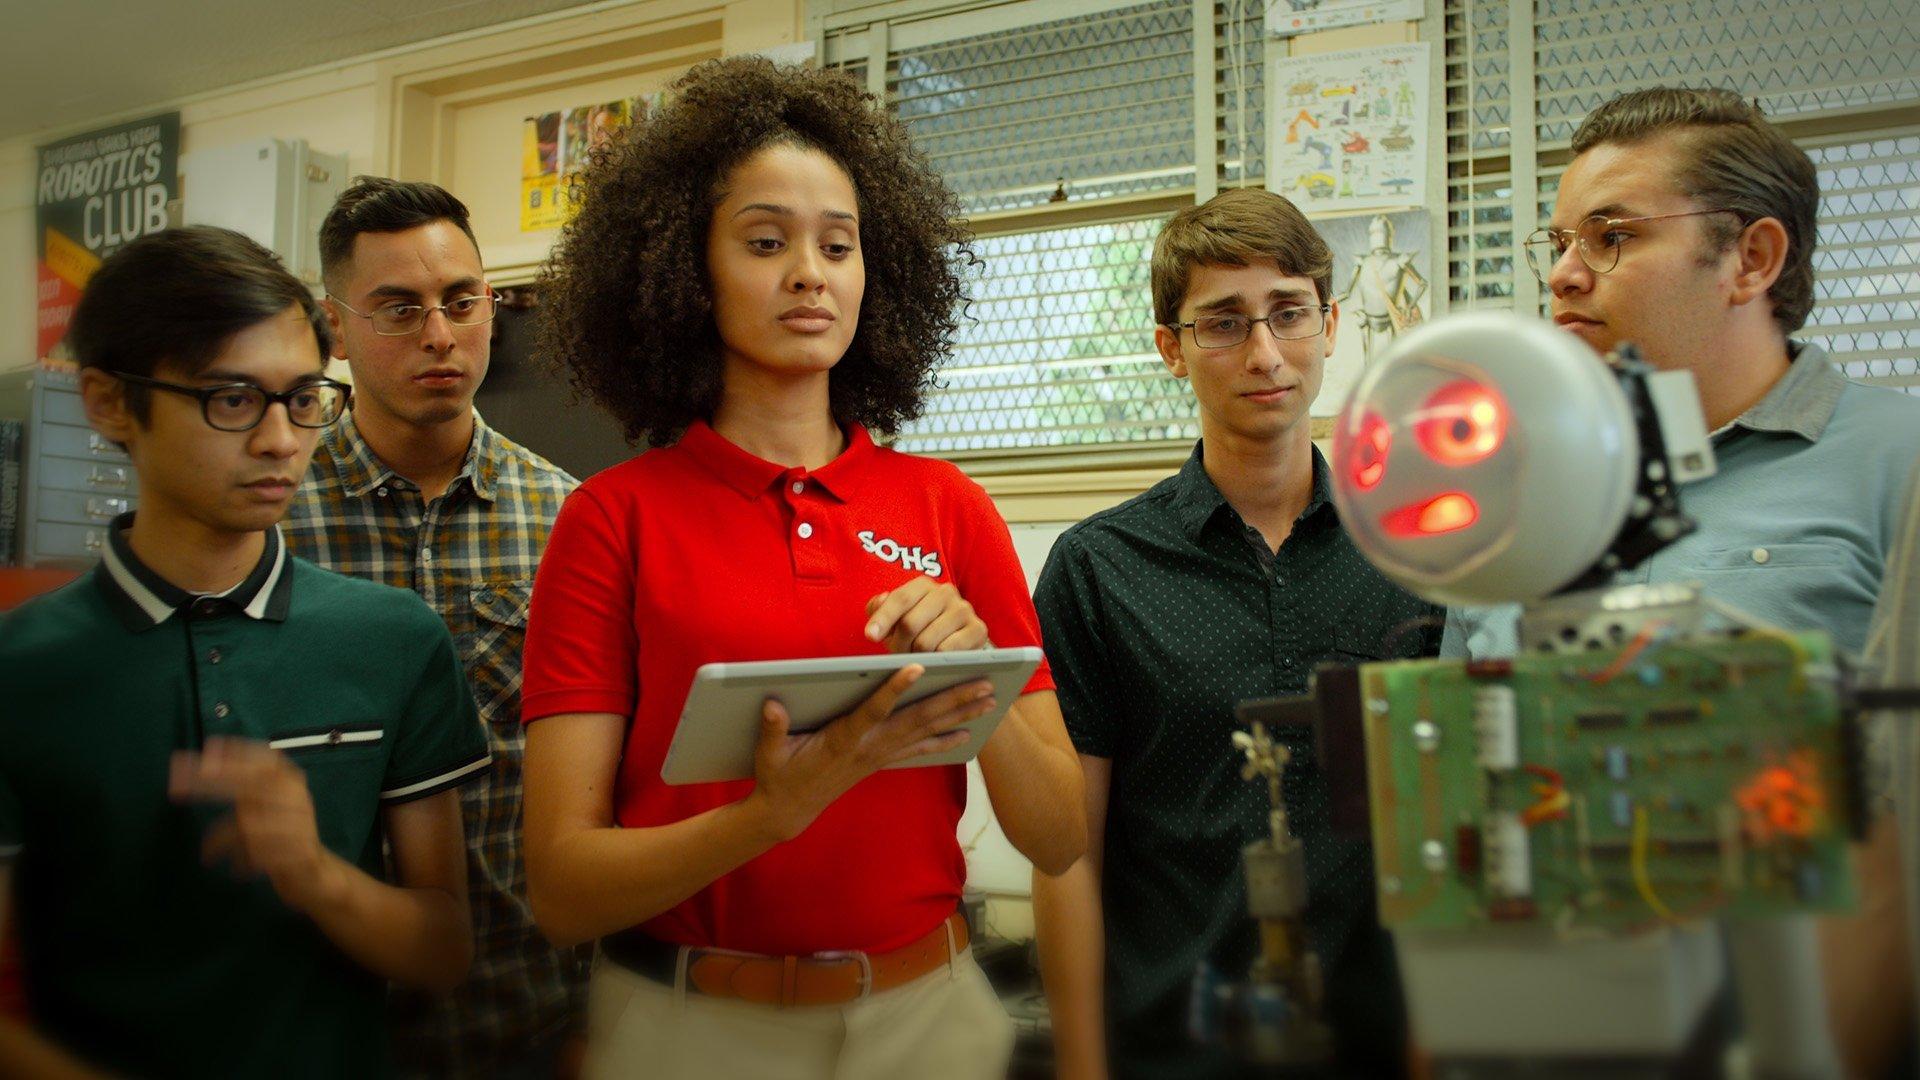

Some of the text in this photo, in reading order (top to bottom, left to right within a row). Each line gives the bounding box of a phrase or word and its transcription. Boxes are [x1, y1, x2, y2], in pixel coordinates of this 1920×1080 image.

[39, 141, 162, 206] ROBOTICS
[83, 182, 168, 250] CLUB
[857, 530, 942, 577] SOHS
